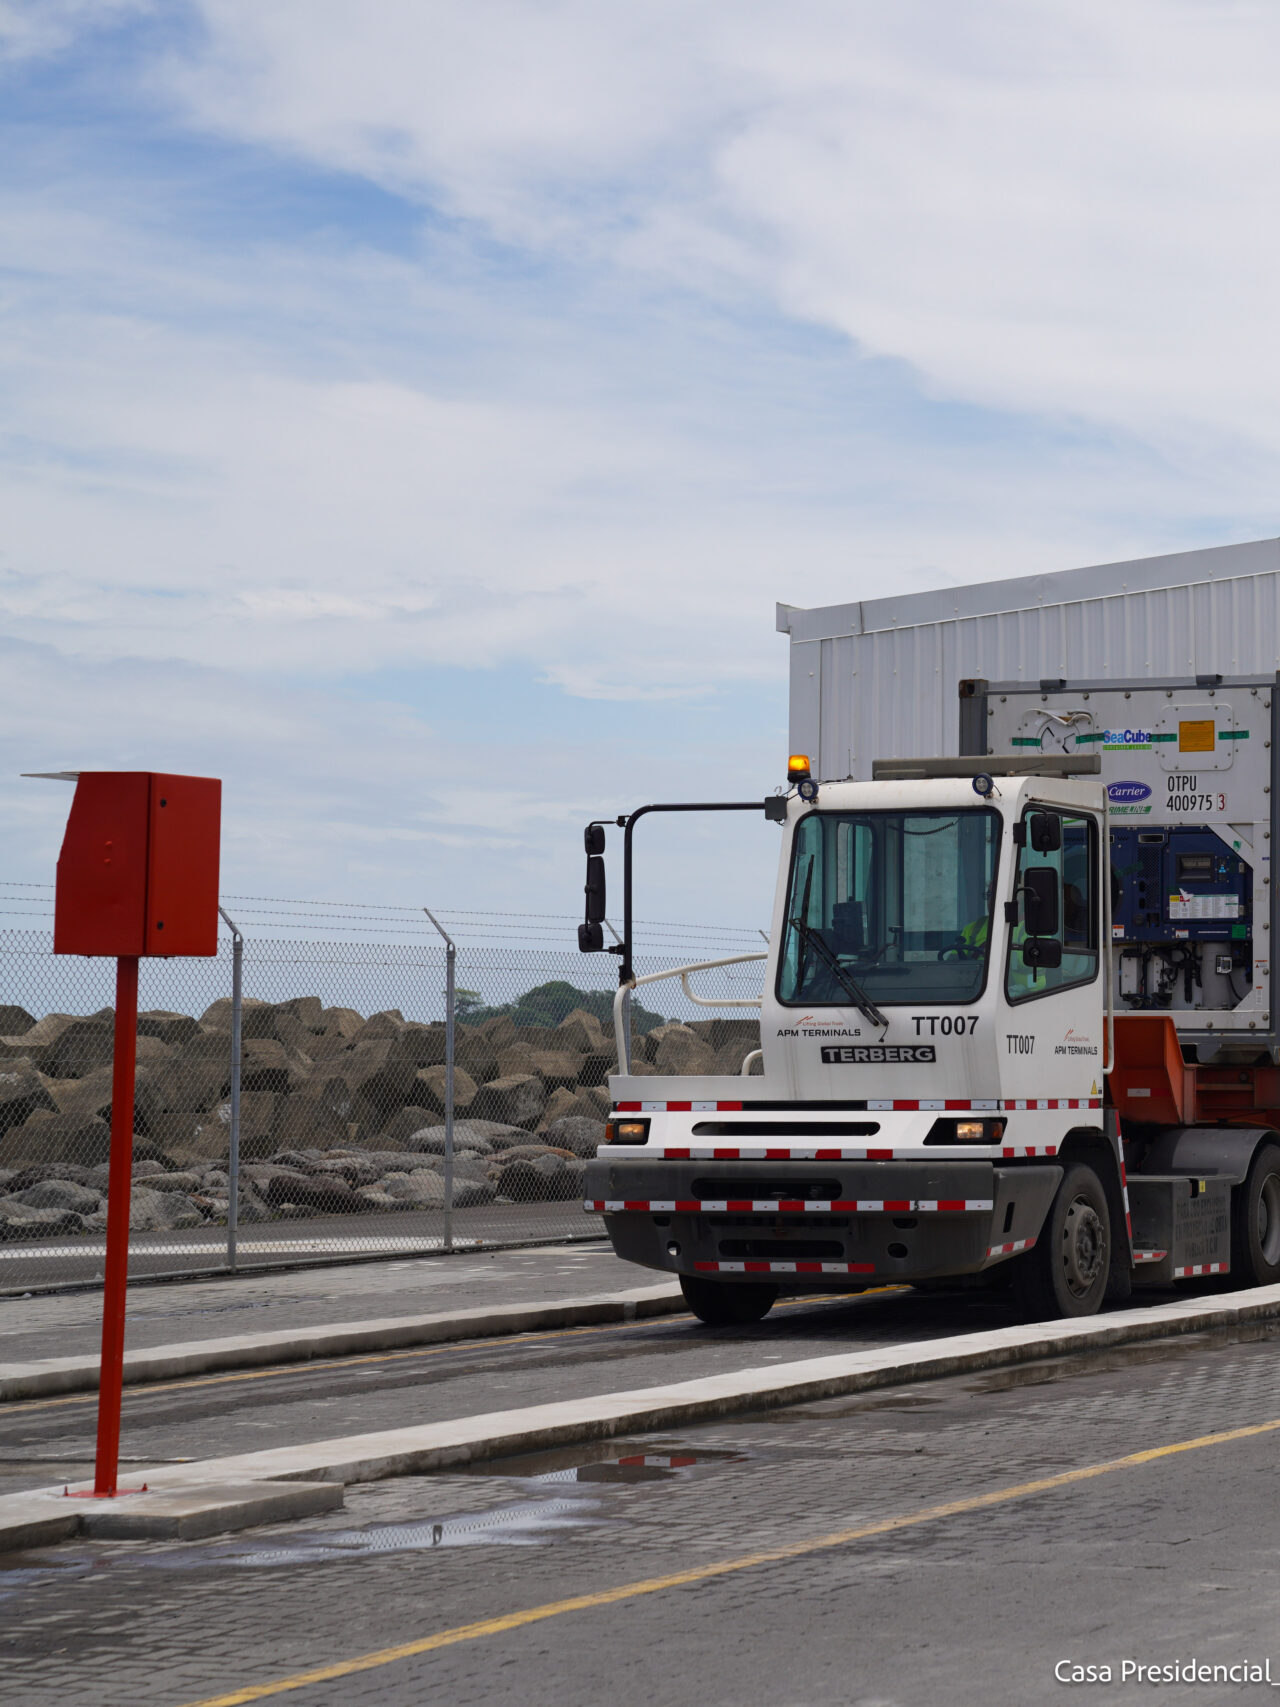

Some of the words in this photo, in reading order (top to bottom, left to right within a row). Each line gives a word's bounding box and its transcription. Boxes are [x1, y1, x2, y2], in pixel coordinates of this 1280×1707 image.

[1103, 729, 1152, 744] SeaCube
[1109, 786, 1146, 796] Carrier
[1167, 775, 1197, 792] OTPU
[1166, 794, 1213, 811] 400975
[1218, 793, 1225, 811] 3
[777, 1029, 799, 1037] APM
[801, 1028, 861, 1037] TERMINALS
[912, 1016, 979, 1036] TT007
[1006, 1034, 1035, 1054] TT007
[1054, 1045, 1067, 1055] APM
[1067, 1046, 1098, 1056] TERMINALS
[823, 1047, 933, 1062] TERBERG
